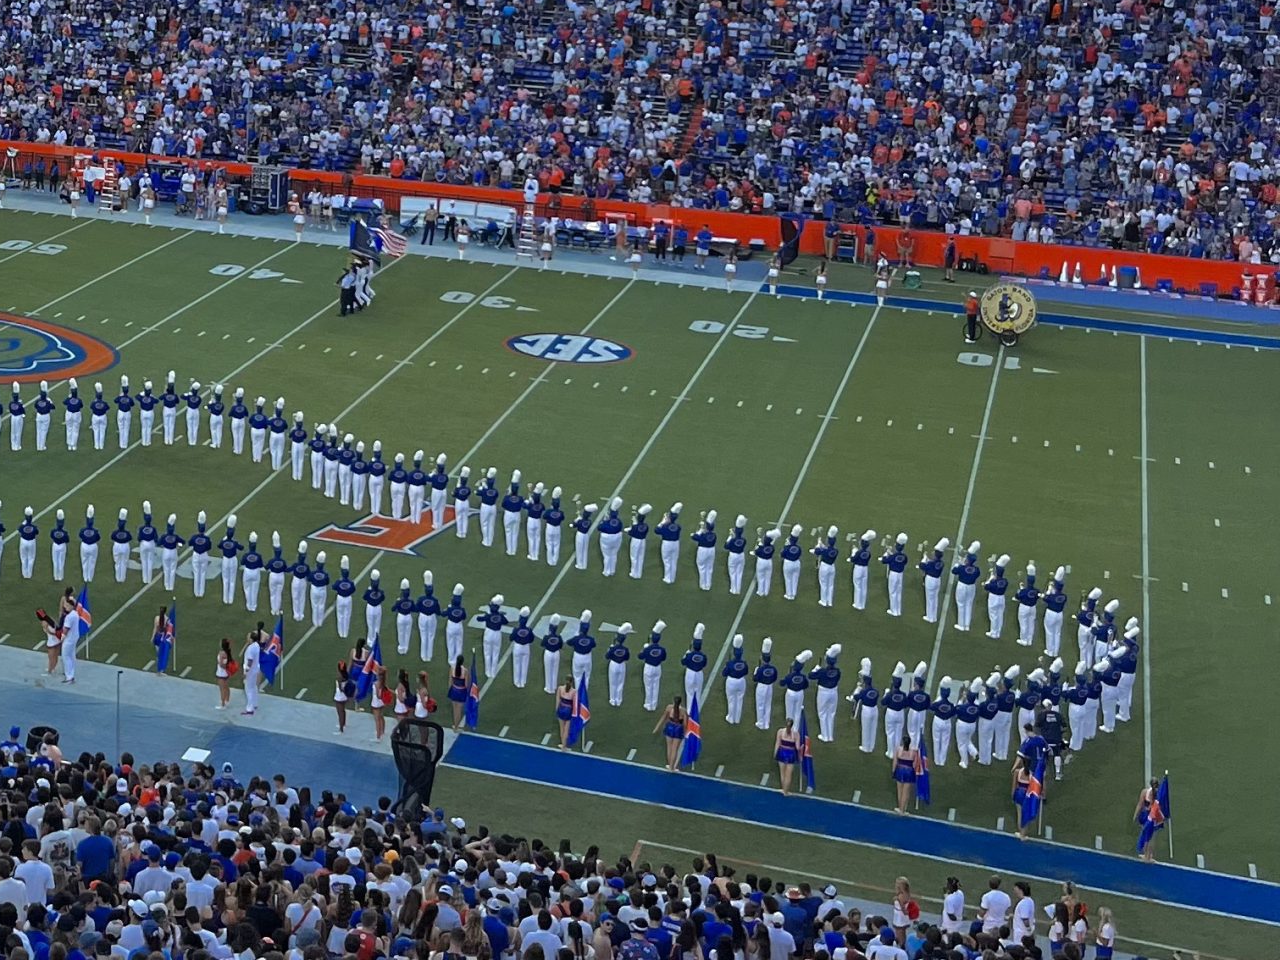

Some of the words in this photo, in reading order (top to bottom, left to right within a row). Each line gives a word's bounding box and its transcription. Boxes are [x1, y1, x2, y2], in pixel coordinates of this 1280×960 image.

[986, 287, 1007, 301] GATOR
[1012, 287, 1031, 302] BAND
[513, 333, 624, 363] SEC
